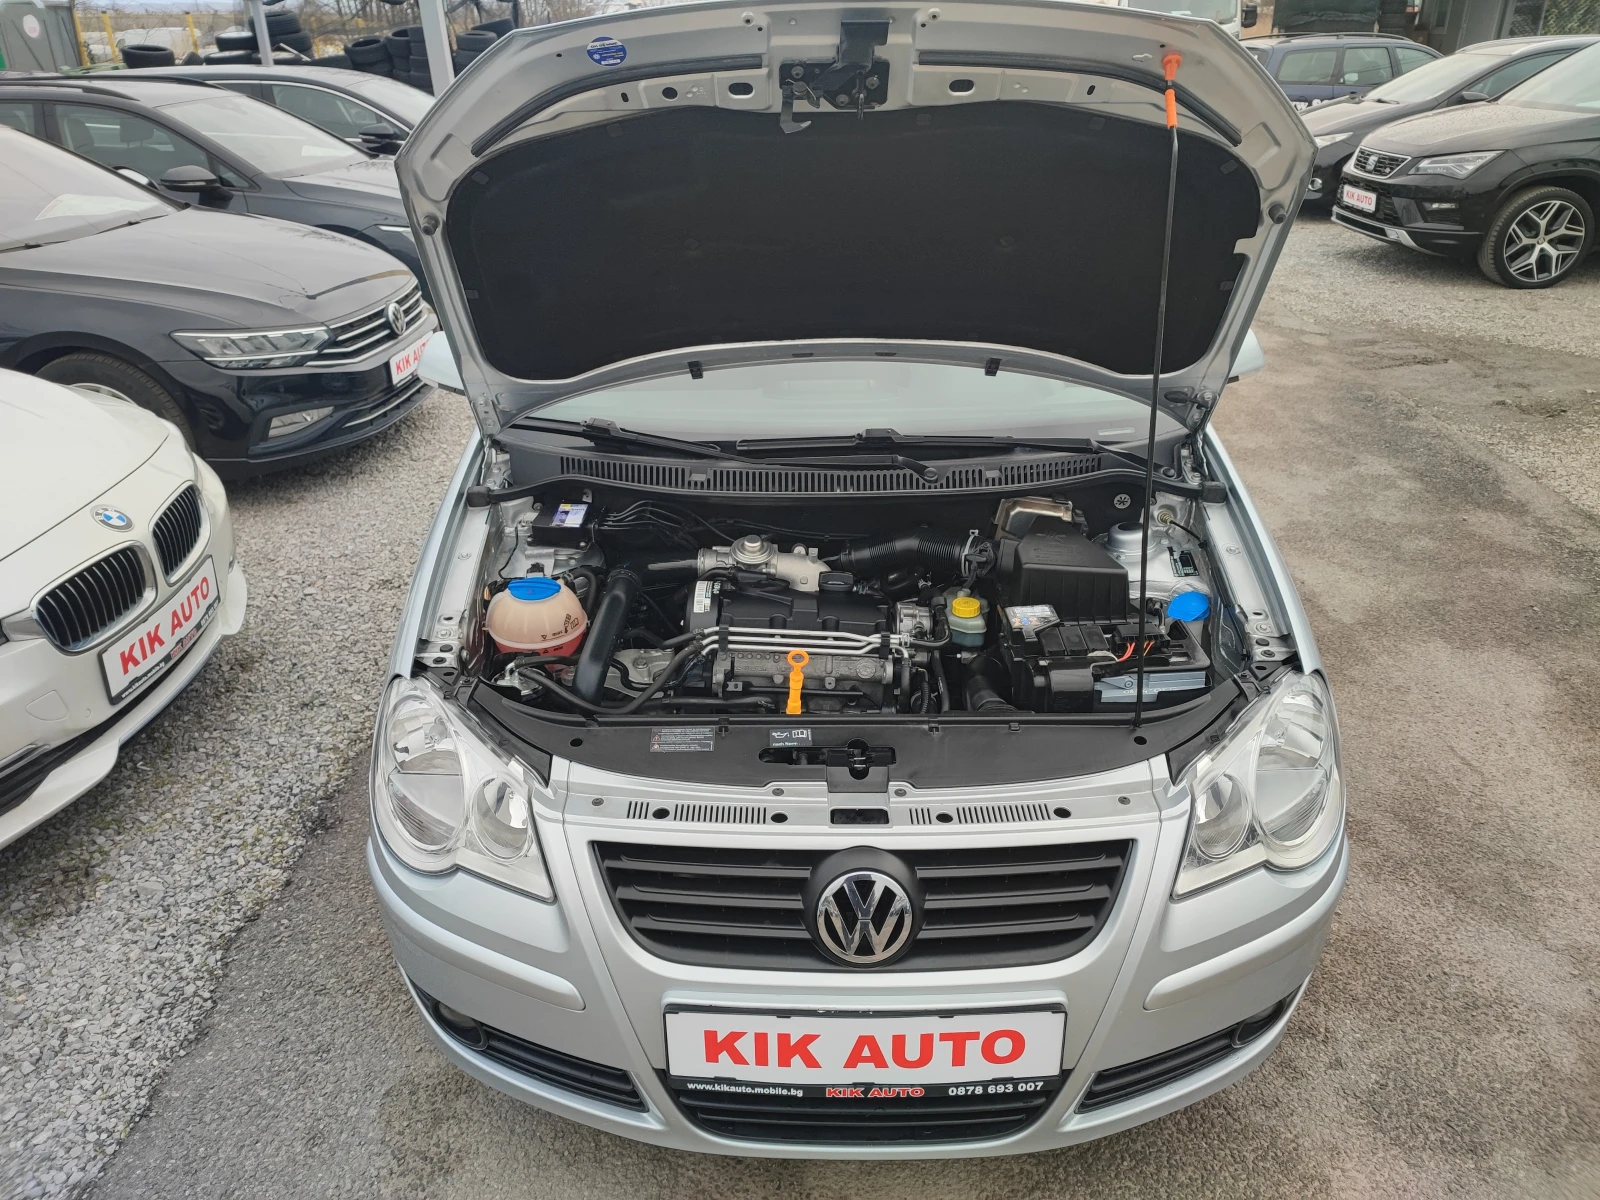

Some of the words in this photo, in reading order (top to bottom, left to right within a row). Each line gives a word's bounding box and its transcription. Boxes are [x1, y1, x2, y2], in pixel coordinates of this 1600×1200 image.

[1346, 190, 1356, 201] KIK
[1356, 193, 1373, 206] AUTO
[395, 353, 411, 375] KIK
[119, 622, 166, 676] KIK
[170, 576, 210, 638] AUTO
[703, 1029, 823, 1069] KIK
[843, 1029, 1026, 1069] AUTO
[686, 1082, 804, 1097] www.kikauto.mobile.bg
[826, 1087, 865, 1098] KIK
[866, 1087, 925, 1098] AUTO
[948, 1086, 983, 1096] 0878
[987, 1084, 1014, 1094] 693
[1017, 1081, 1044, 1092] 007
